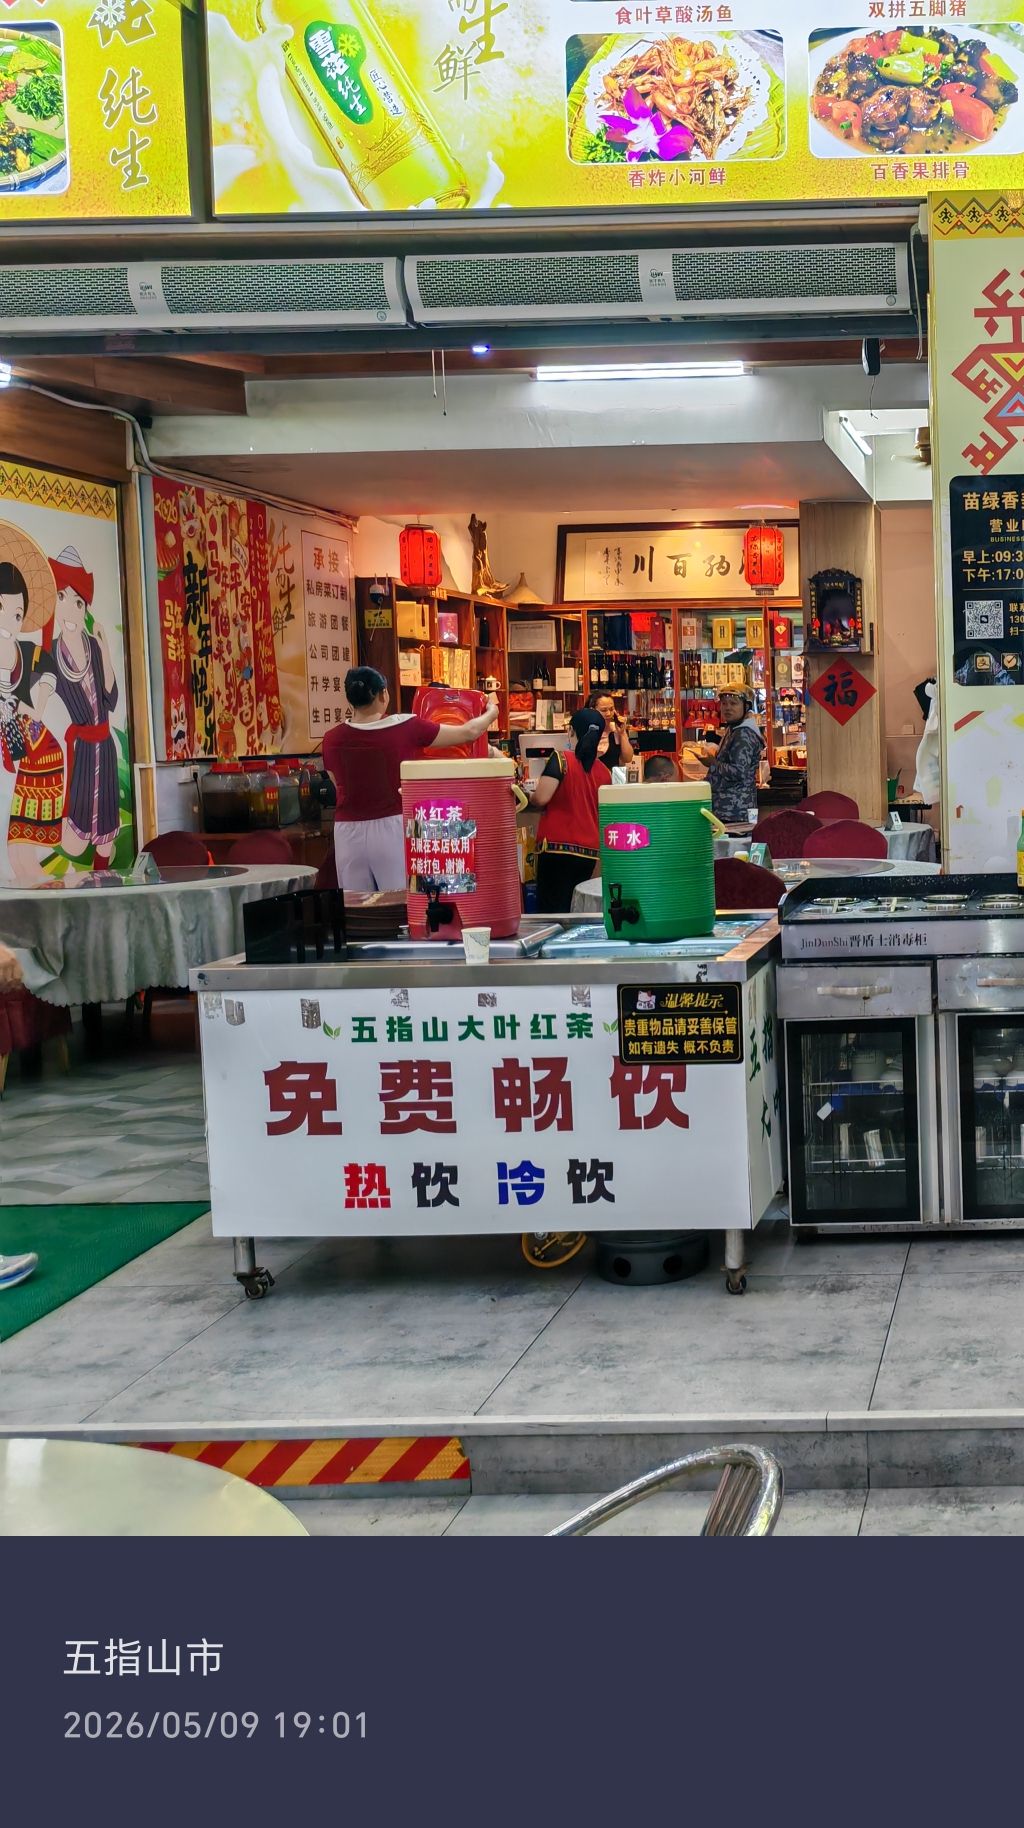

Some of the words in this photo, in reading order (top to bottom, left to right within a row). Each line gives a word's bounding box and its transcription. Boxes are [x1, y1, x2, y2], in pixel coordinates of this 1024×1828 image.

[615, 5, 733, 25] 食叶草酸汤鱼
[868, 0, 967, 18] 双拼五脚猪
[628, 167, 727, 188] 香炸小河鲜
[871, 161, 971, 180] 百香果排骨
[990, 535, 1024, 543] BUSINESS
[313, 546, 340, 574] 承接
[306, 579, 348, 601] 私房菜订制
[307, 611, 349, 633] 旅游团餐
[1010, 616, 1024, 624] 130
[309, 643, 351, 663] 公司团建
[823, 671, 858, 707] 福
[415, 806, 463, 822] 冰红茶
[608, 830, 641, 846] 开水
[664, 992, 724, 1009] 温馨提示
[350, 1012, 594, 1043] 五指山大叶红茶
[624, 1017, 738, 1037] 贵重物品请妥善保管
[628, 1041, 679, 1055] 如有遗失
[683, 1040, 734, 1054] 概不负责
[263, 1056, 690, 1137] 免费畅饮
[343, 1161, 460, 1209] 热饮
[496, 1157, 616, 1206] 冷饮
